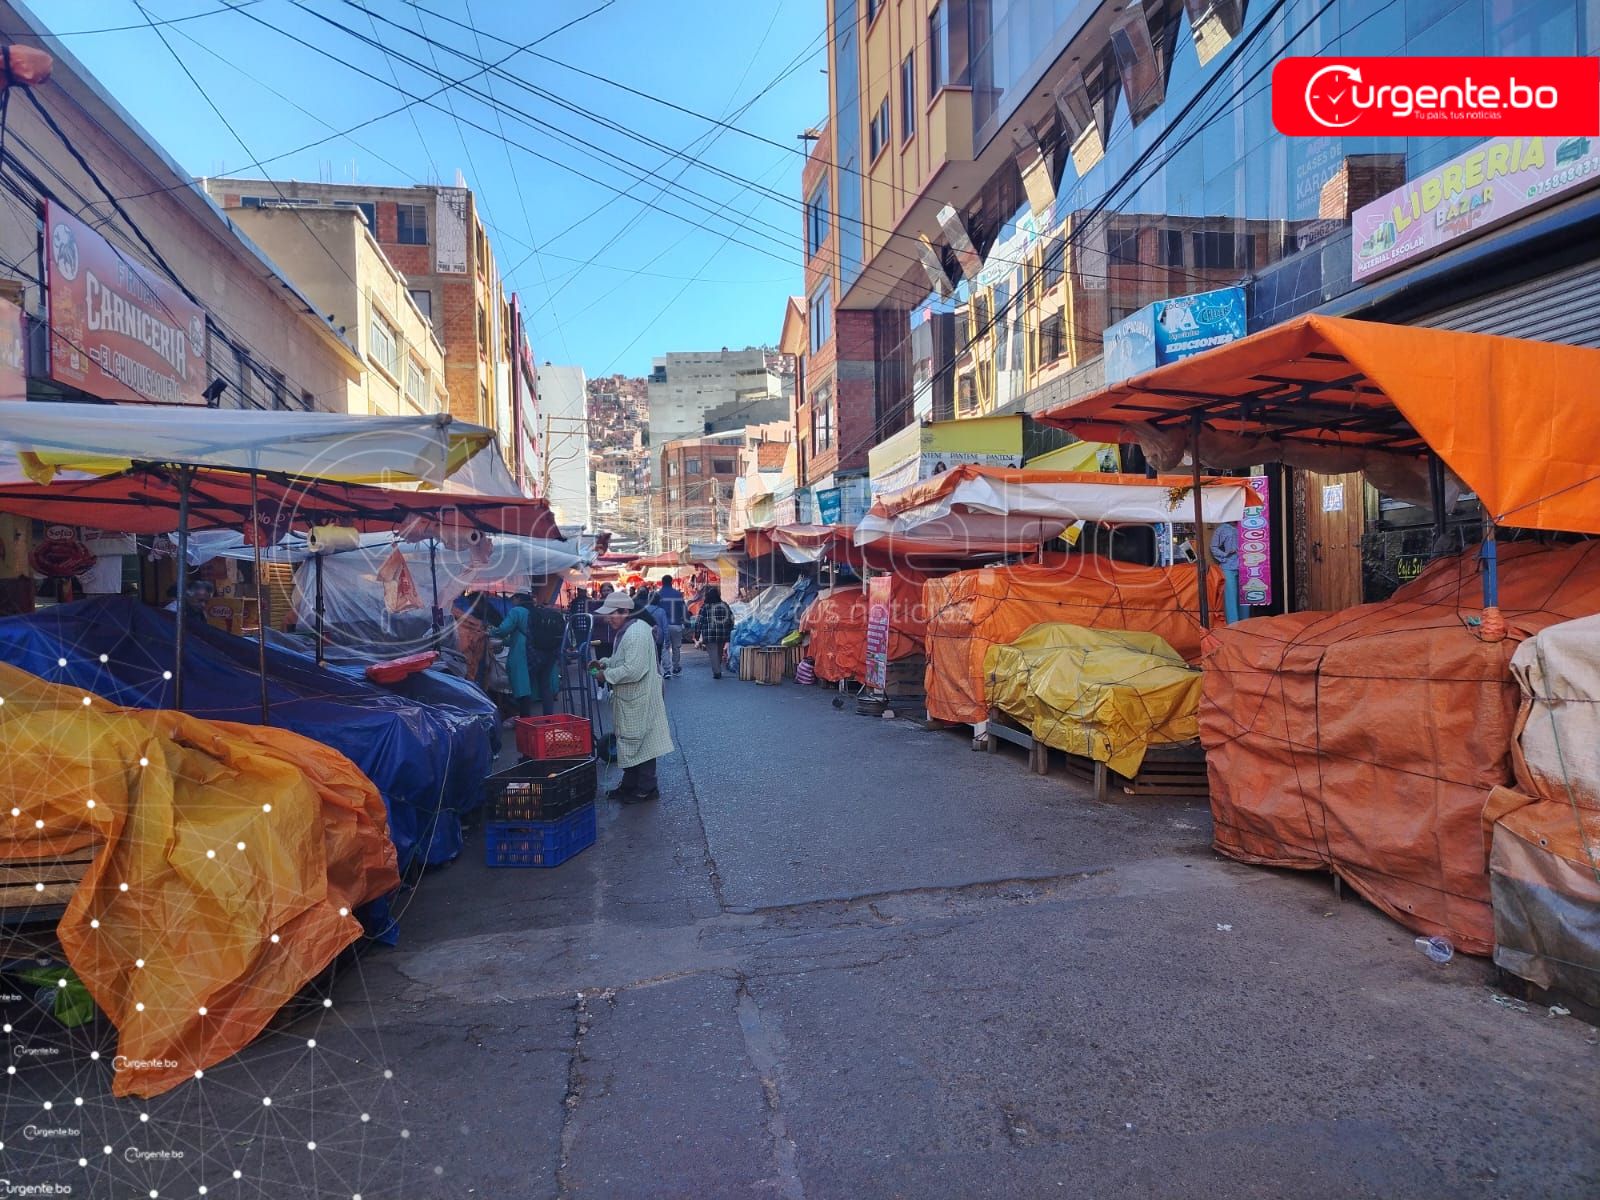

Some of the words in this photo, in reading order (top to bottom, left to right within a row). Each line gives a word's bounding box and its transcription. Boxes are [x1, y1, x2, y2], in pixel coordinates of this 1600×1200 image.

[1392, 137, 1546, 233] LIBRERIA
[1436, 187, 1494, 228] BAZAR
[1358, 254, 1390, 272] MATERIAL
[1391, 237, 1425, 258] ESCOLAR
[86, 271, 187, 381] CARNICERIA
[1241, 479, 1268, 601] FTOCOPIAS
